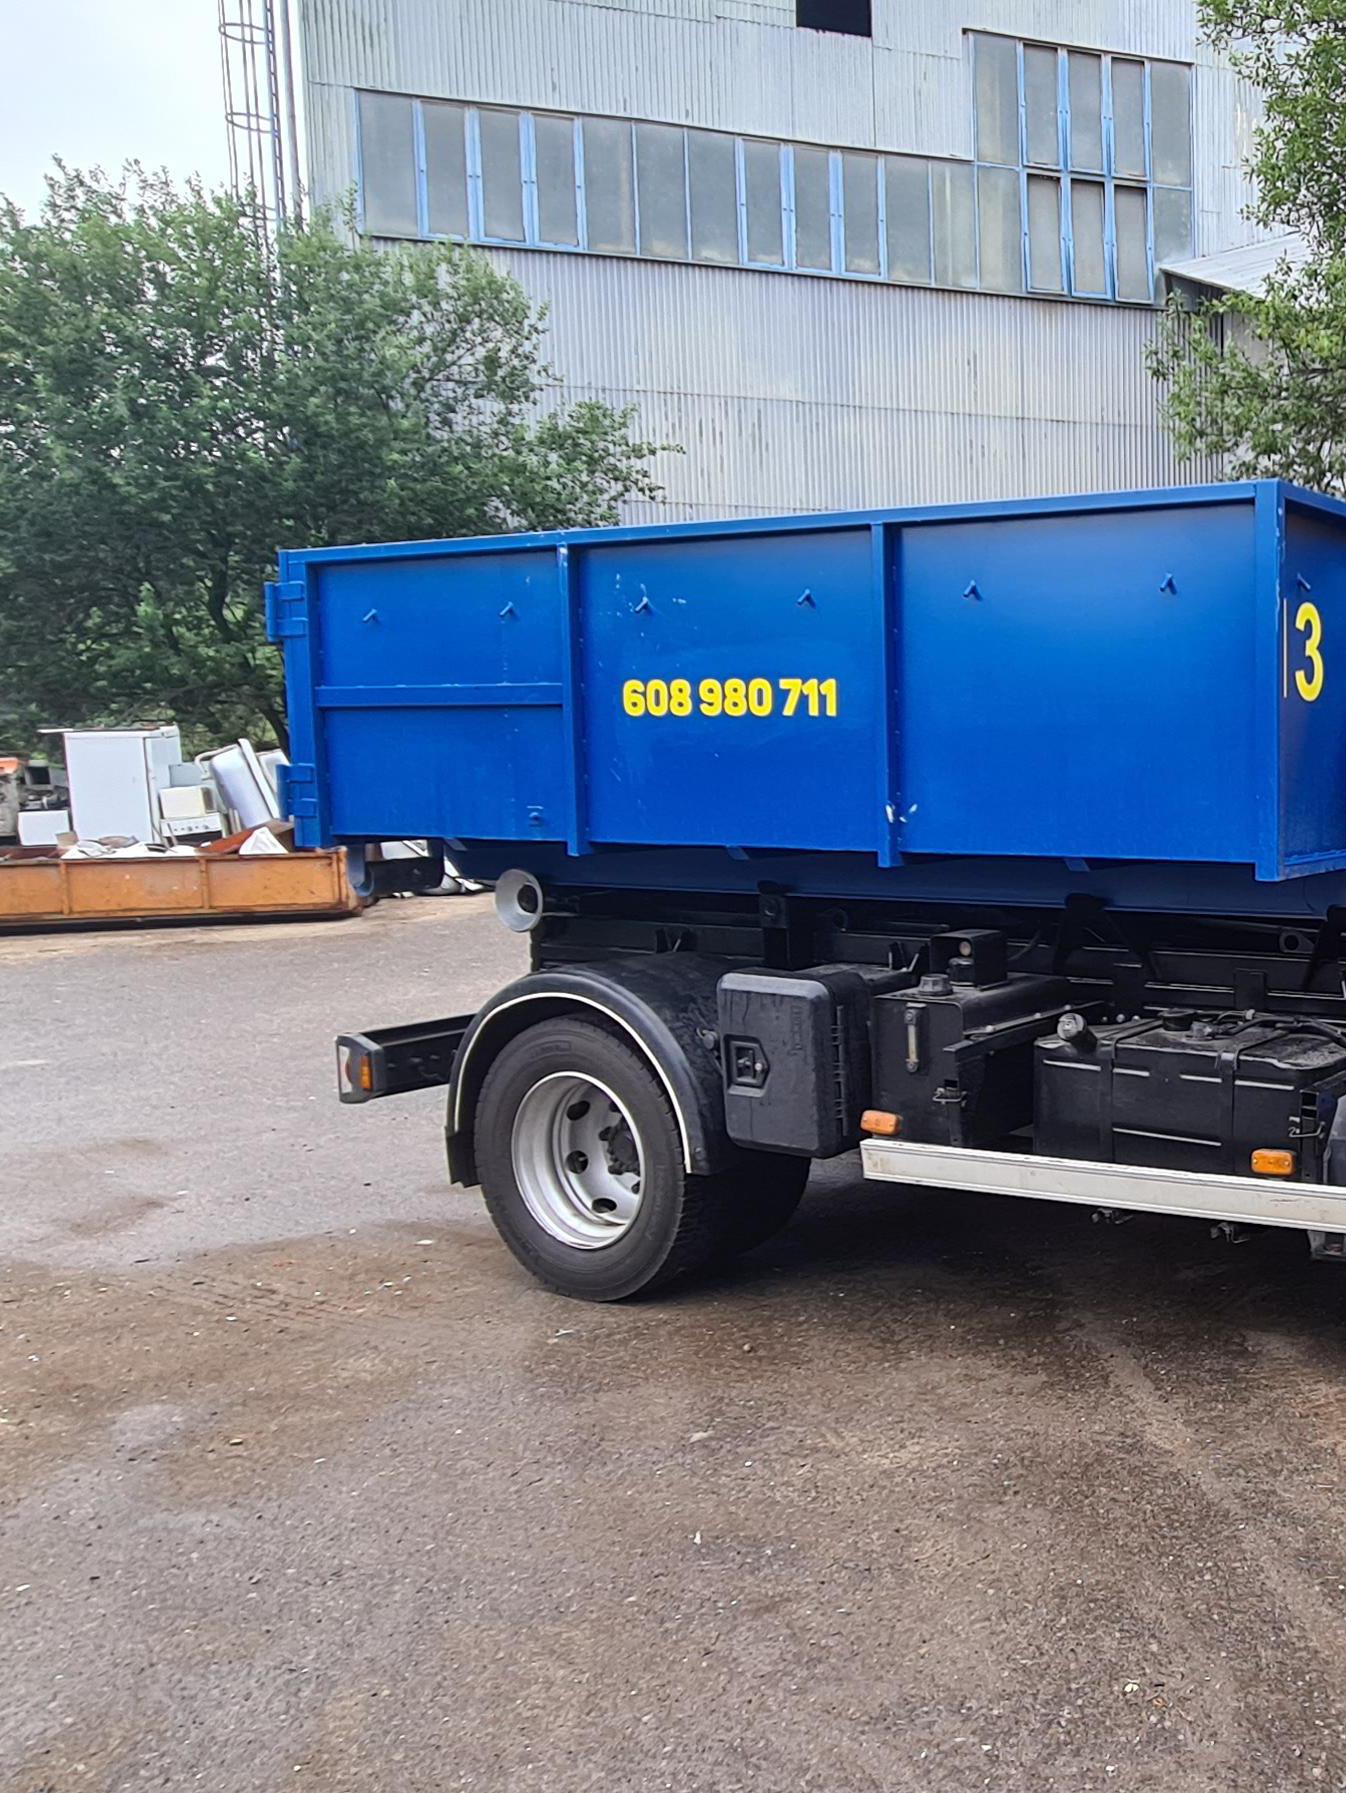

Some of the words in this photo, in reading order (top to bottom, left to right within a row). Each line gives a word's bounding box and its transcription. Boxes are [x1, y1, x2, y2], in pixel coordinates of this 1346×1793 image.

[623, 678, 693, 717] 608
[698, 677, 773, 717] 980
[778, 677, 838, 717] 711
